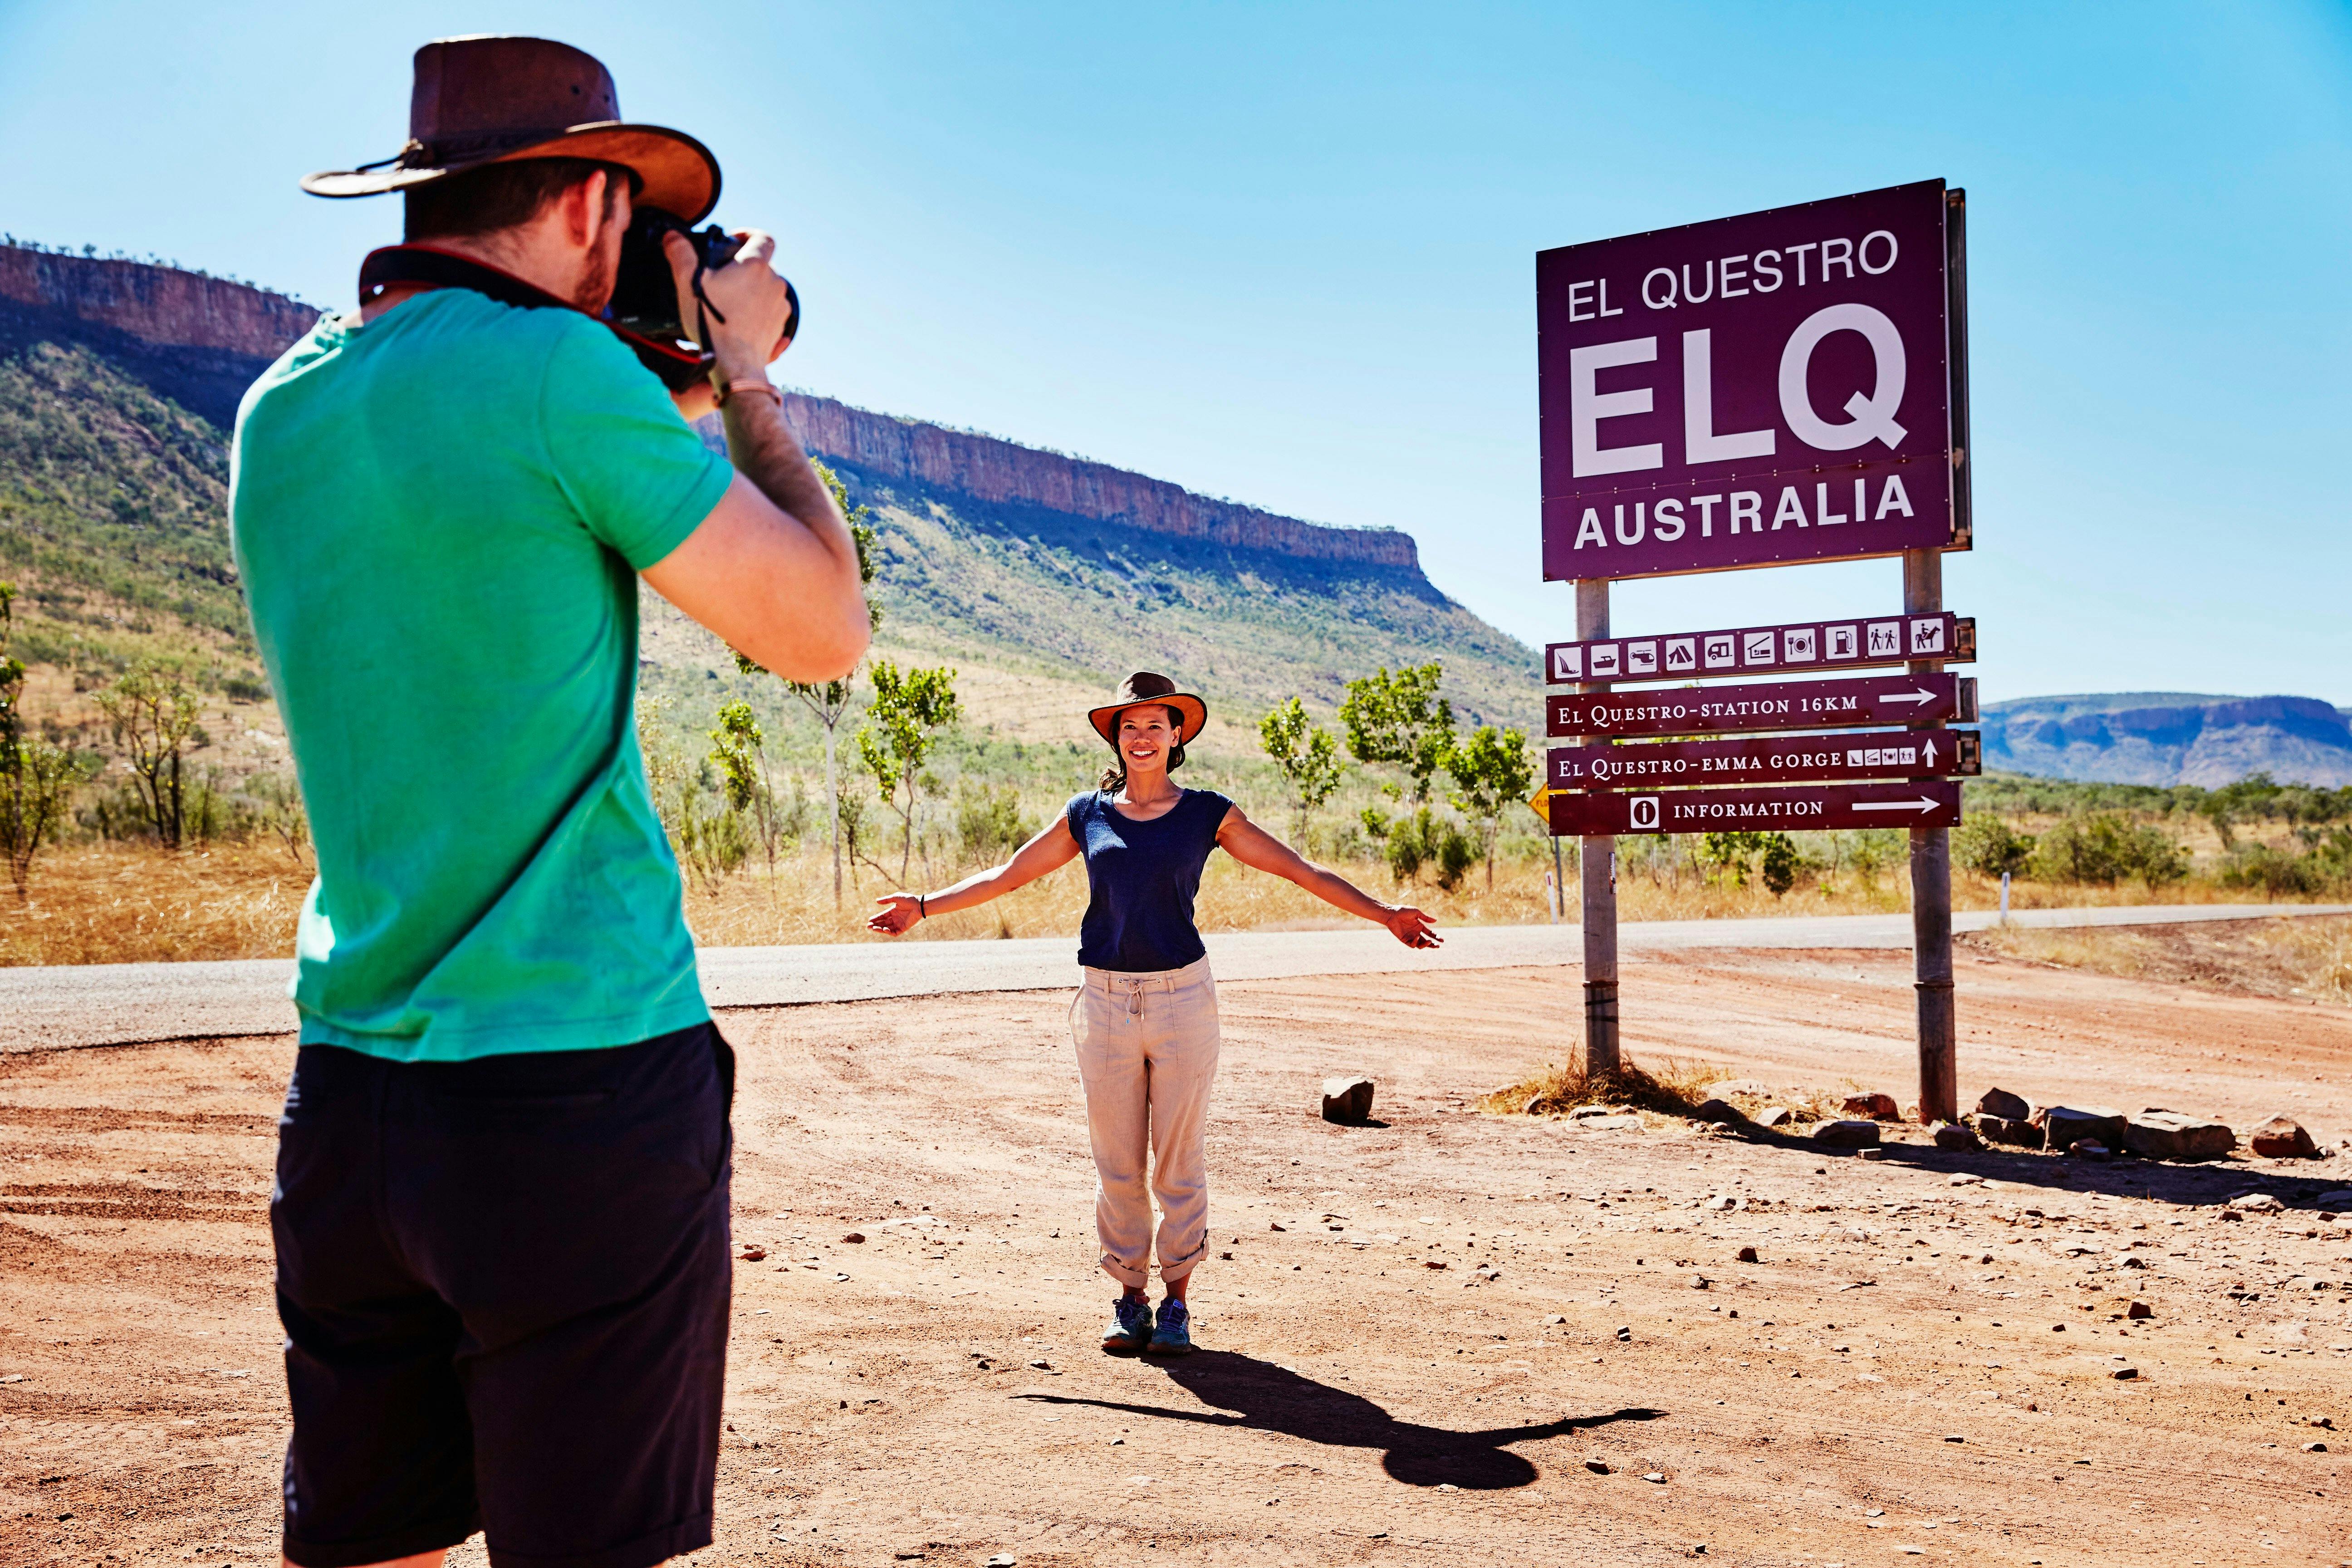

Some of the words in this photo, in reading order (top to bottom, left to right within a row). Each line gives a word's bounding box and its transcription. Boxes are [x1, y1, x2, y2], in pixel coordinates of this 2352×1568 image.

[1568, 278, 1623, 322] EL
[1642, 230, 1898, 310] QUESTRO
[1570, 303, 1908, 478] ELQ
[1573, 474, 1914, 550] AUSTRALIA
[1801, 696, 1857, 712] 16KM
[1770, 752, 1841, 769] GORGE
[1674, 801, 1823, 818] INFORMATION
